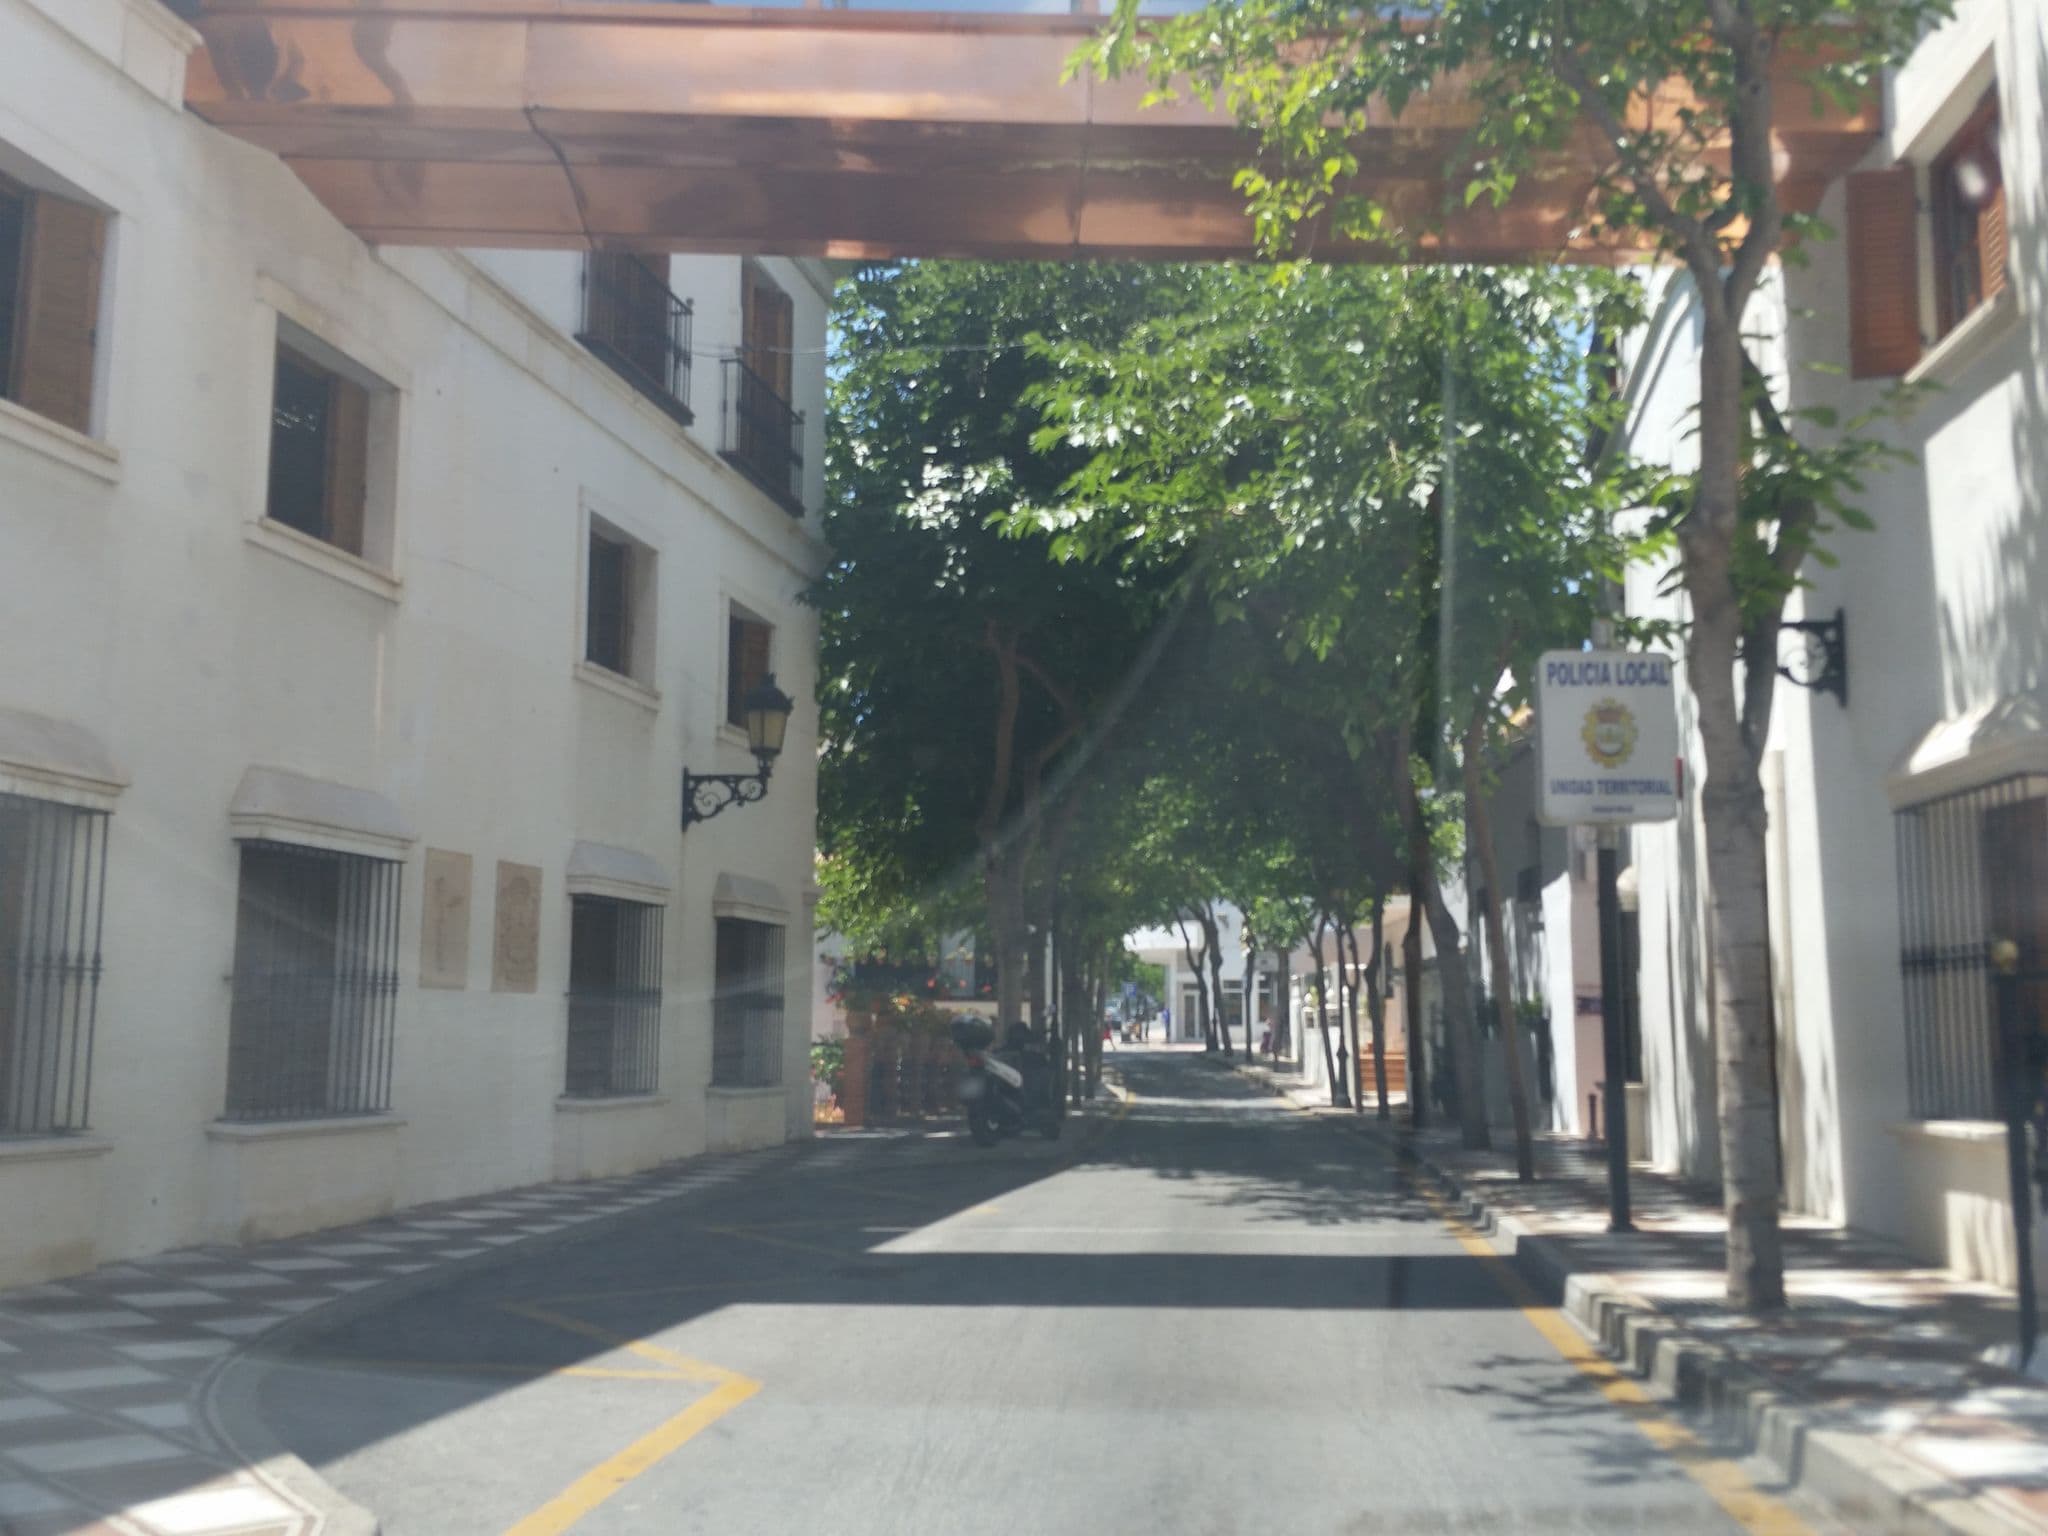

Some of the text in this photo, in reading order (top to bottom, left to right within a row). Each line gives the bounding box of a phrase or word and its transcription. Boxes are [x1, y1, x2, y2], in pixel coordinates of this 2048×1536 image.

[1547, 661, 1669, 686] POLICIA LOCAL
[1551, 778, 1672, 795] UNIDAD TERRITORIAL
